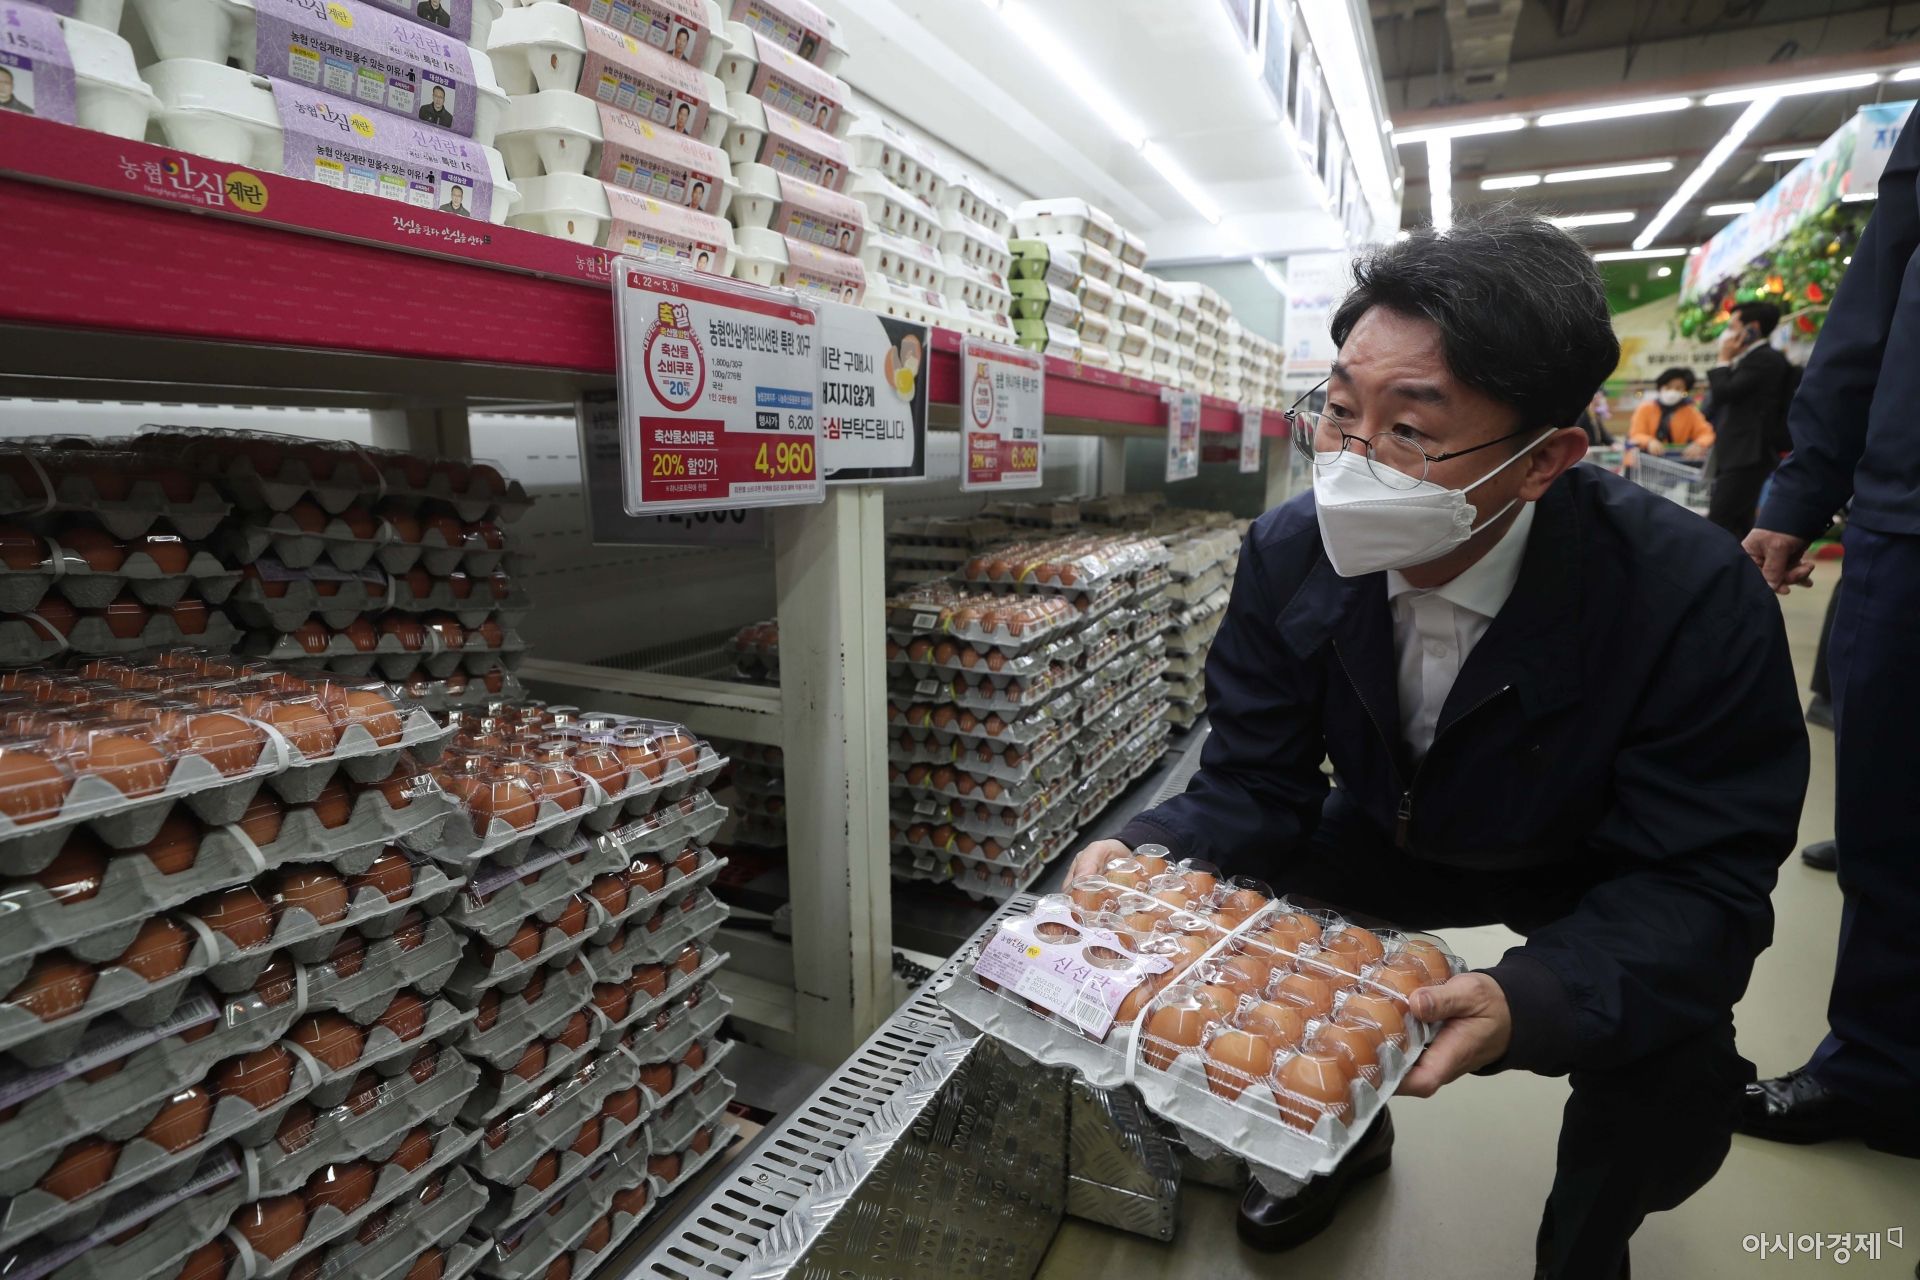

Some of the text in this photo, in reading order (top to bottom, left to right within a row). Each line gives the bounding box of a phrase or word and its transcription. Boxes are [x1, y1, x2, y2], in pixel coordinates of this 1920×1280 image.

[392, 25, 440, 56] 신선란
[290, 31, 404, 79] 농협 안심계란 믿을수 있는 이유!
[295, 100, 317, 118] 농협
[318, 103, 350, 132] 안심
[412, 128, 457, 156] 신선란
[316, 145, 424, 181] 농협 안심계란 믿을수 있는 이유!
[118, 155, 264, 207] 농협 안심 계란
[392, 216, 421, 235] 진심을
[441, 228, 467, 244] 안심을
[575, 254, 595, 273] 농협
[642, 276, 652, 287] 22
[671, 283, 679, 293] 31
[661, 343, 689, 359] 축산물
[709, 319, 811, 358] 농협안심계란신선란 특란 30구
[658, 360, 694, 376] 소비쿠폰
[844, 351, 874, 374] 구매시
[712, 382, 723, 391] 국산
[758, 414, 813, 431] 행사가 6,200
[655, 429, 715, 446] 축산물소비쿠폰
[652, 454, 718, 477] 20% 할인가
[755, 442, 813, 478] 4,960
[1052, 955, 1111, 992] 신선란
